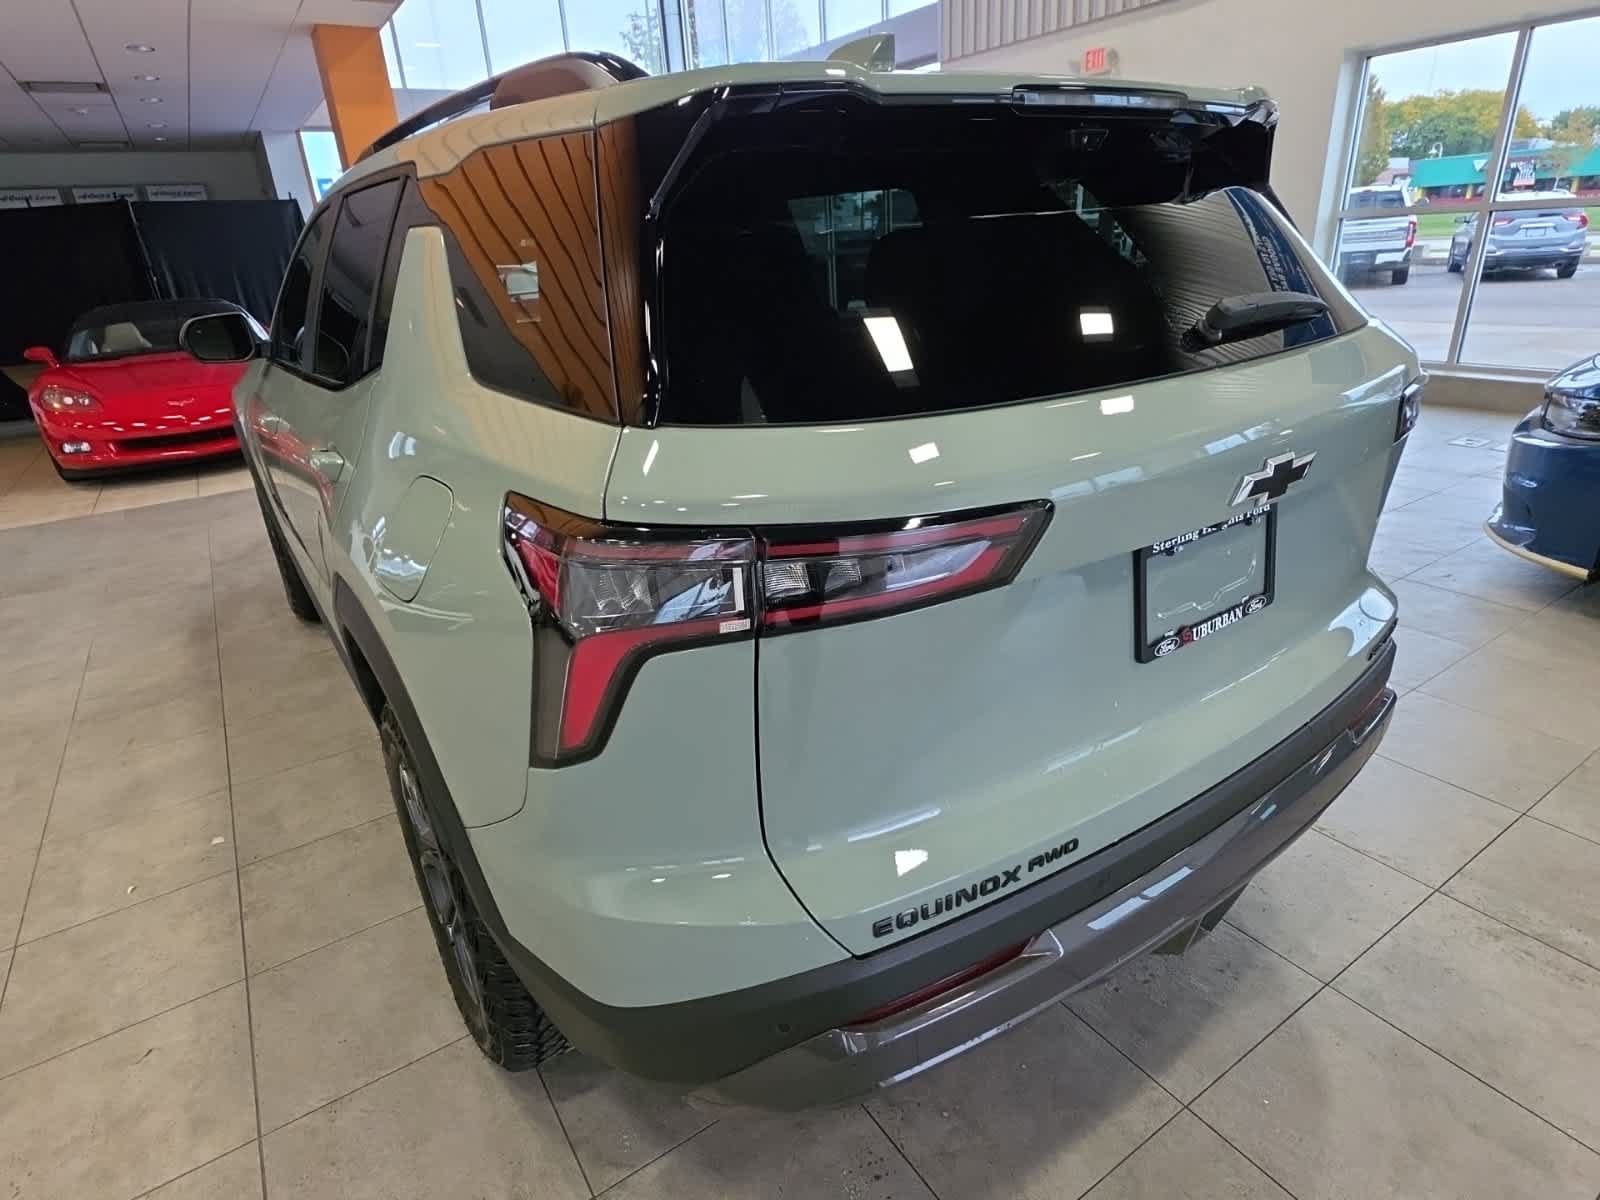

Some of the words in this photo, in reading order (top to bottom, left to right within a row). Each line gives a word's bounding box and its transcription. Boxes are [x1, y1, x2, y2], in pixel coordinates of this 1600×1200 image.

[1086, 49, 1105, 71] EXIT
[1152, 529, 1199, 554] Sterling
[1183, 605, 1243, 645] SUBURBAN
[872, 864, 1022, 939] EQUINOX
[1028, 837, 1080, 873] AWD
